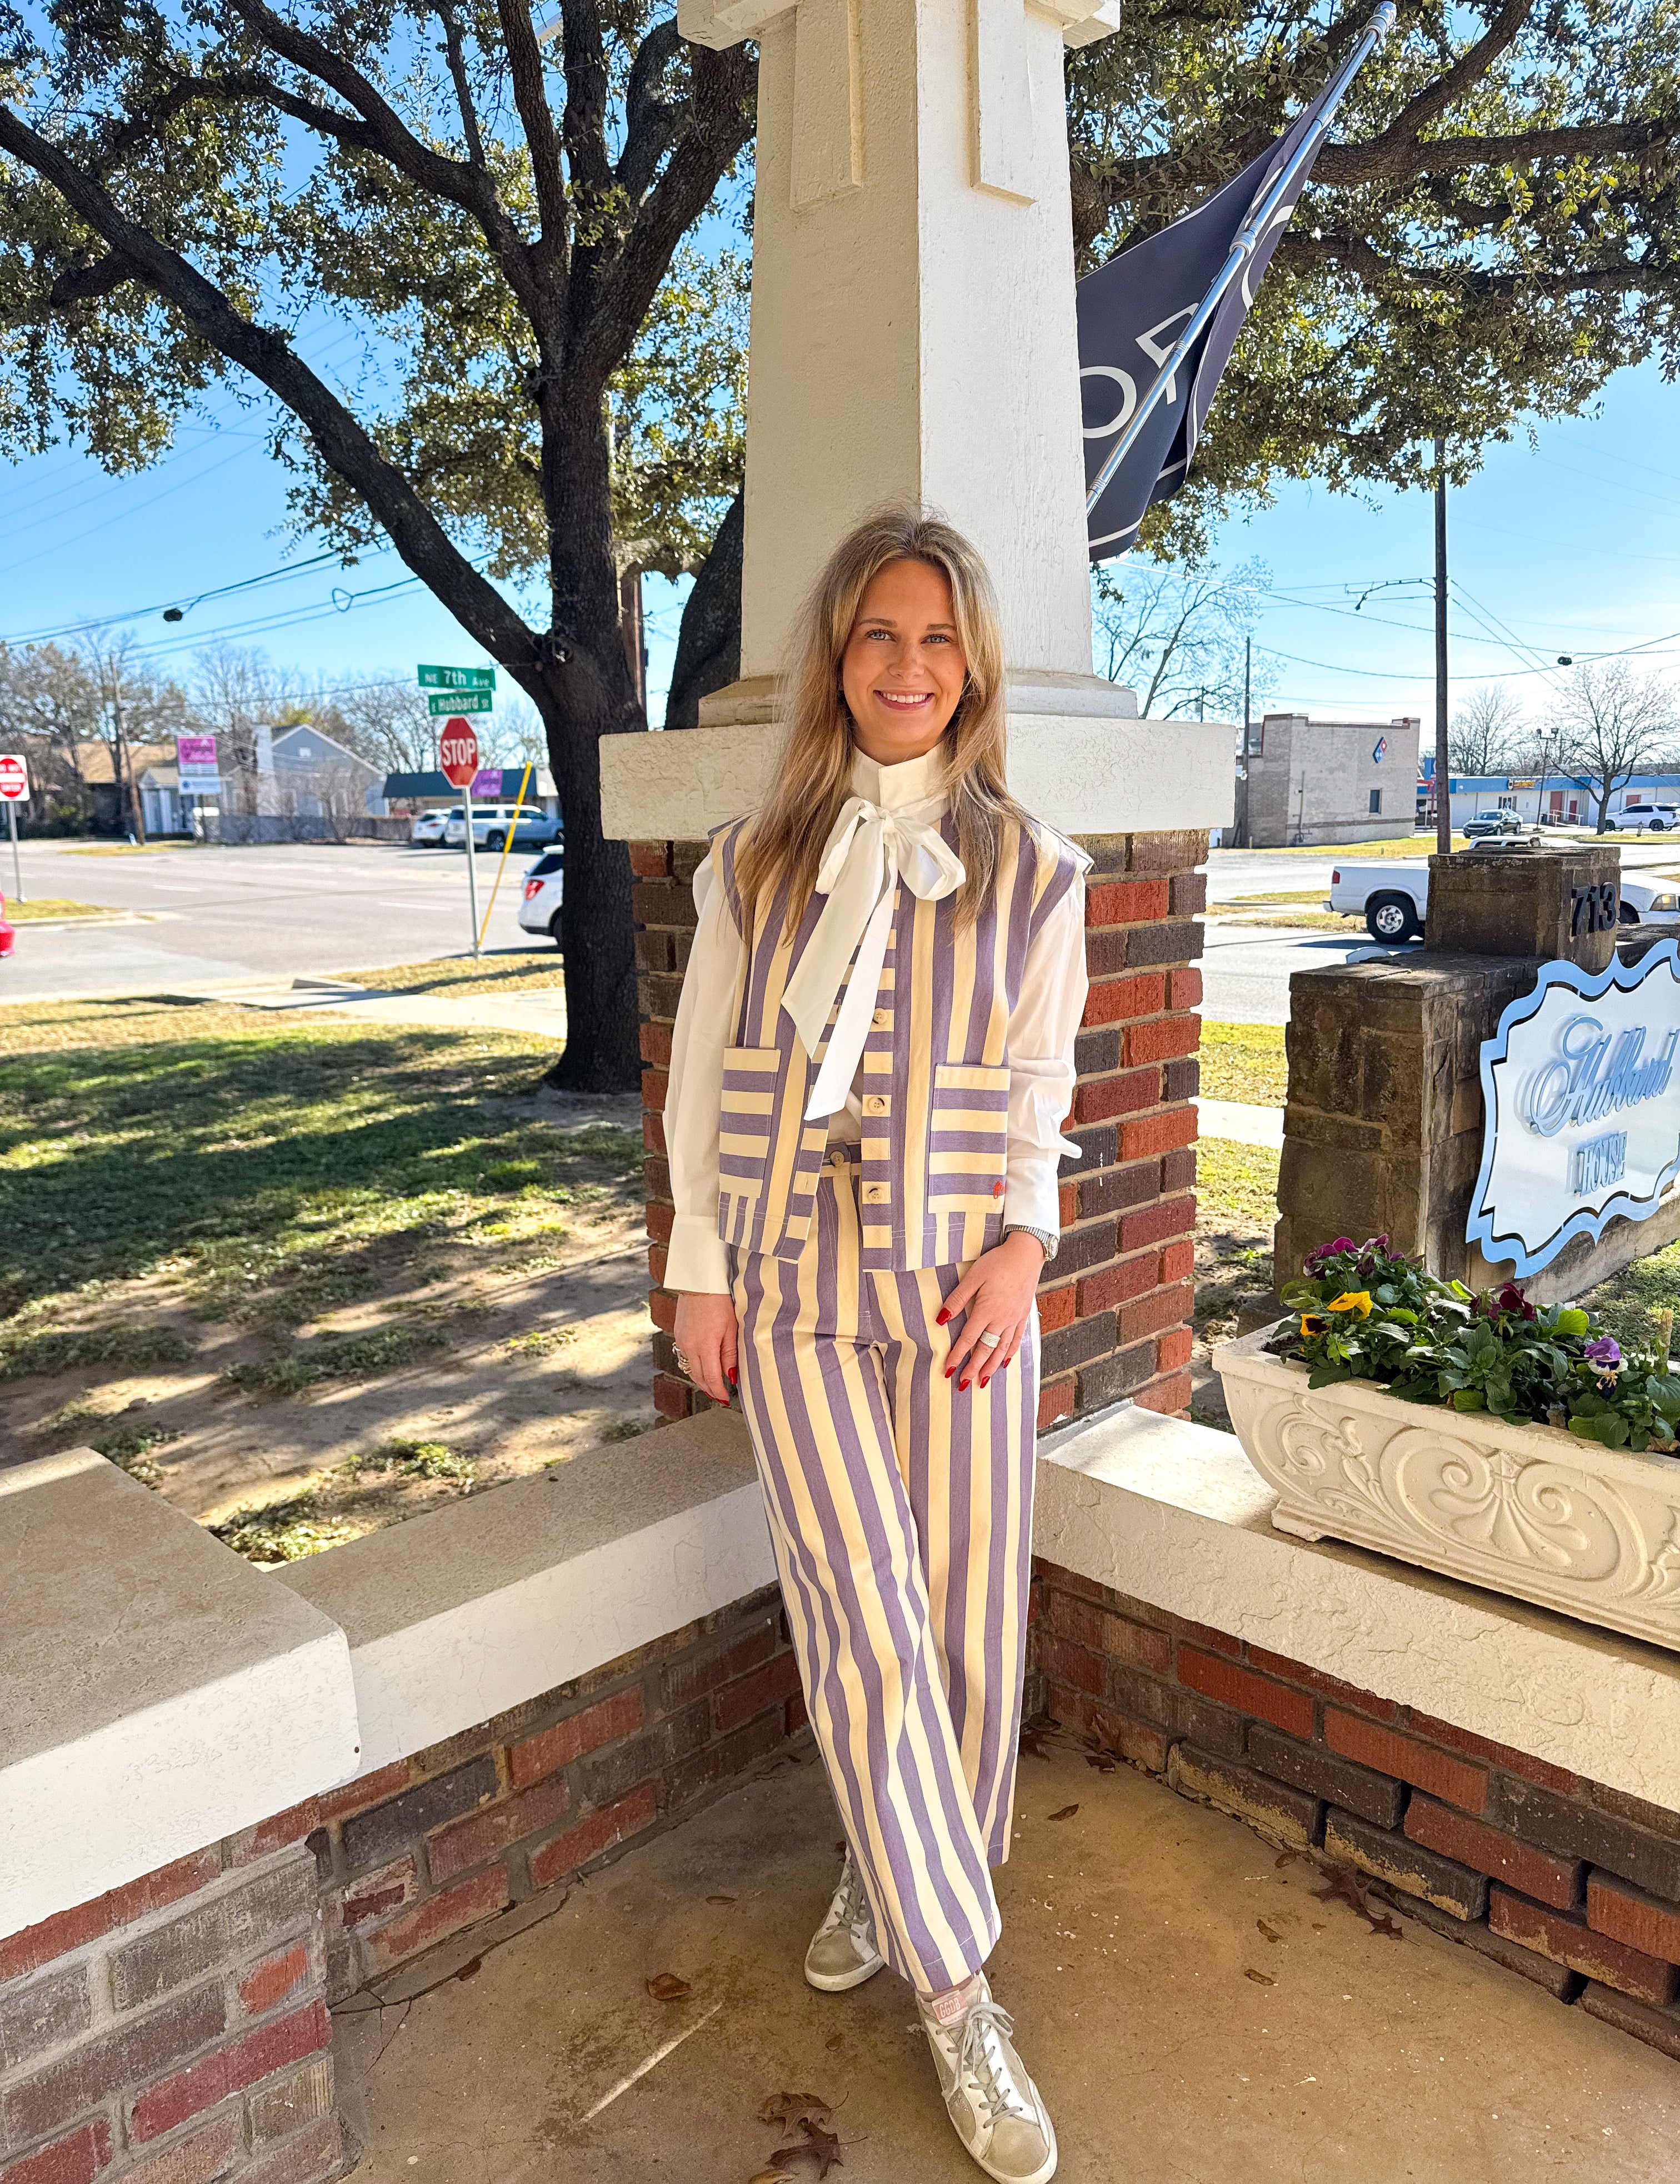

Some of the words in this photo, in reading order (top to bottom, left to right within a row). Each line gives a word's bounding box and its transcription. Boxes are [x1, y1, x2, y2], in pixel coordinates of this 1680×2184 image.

[425, 673, 437, 684] NE
[444, 670, 467, 686] 7th
[472, 677, 489, 687] Ave
[442, 738, 476, 766] STOP
[1571, 882, 1616, 937] 713
[1579, 1131, 1628, 1197] HOUSE
[939, 1997, 961, 2018] GGDB
